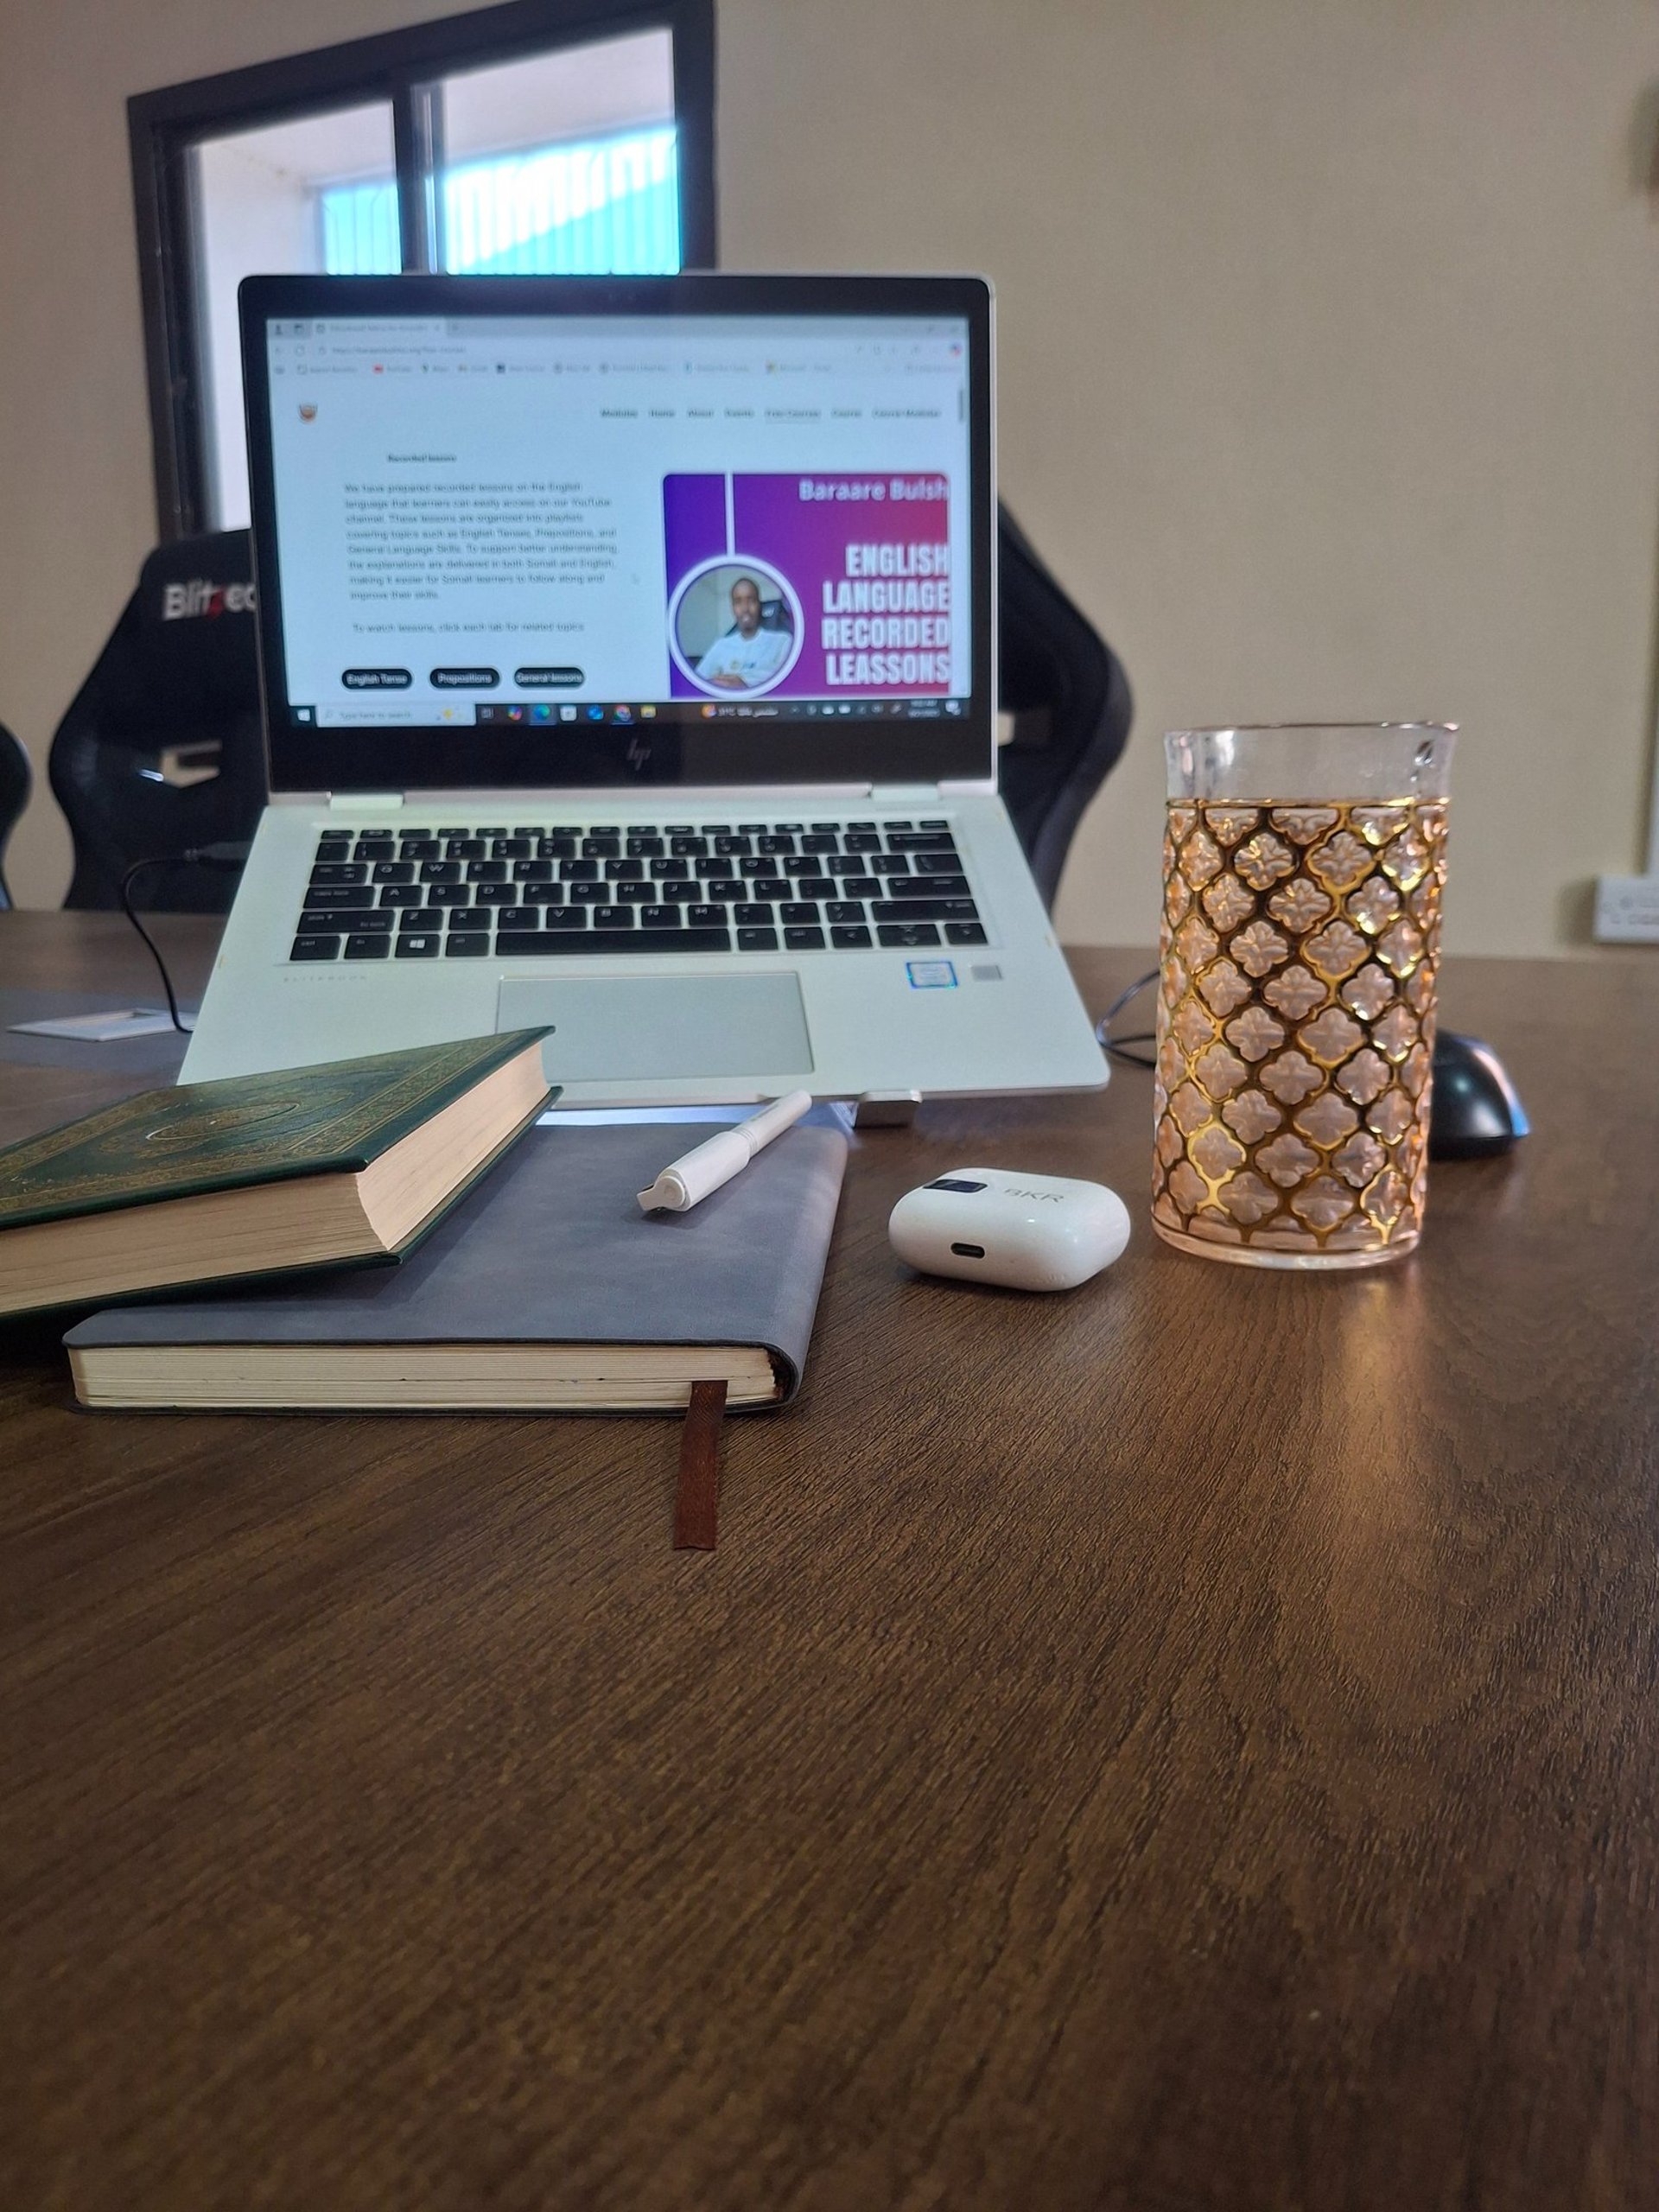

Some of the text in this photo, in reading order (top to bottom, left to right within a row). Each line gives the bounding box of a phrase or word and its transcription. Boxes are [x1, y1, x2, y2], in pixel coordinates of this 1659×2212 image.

[798, 480, 887, 503] Baraare
[844, 543, 950, 577] ENGLISH
[823, 580, 950, 614] LANGUAGE
[821, 616, 950, 650] RECORDED
[346, 672, 379, 687] English
[825, 652, 950, 686] LEASSONS
